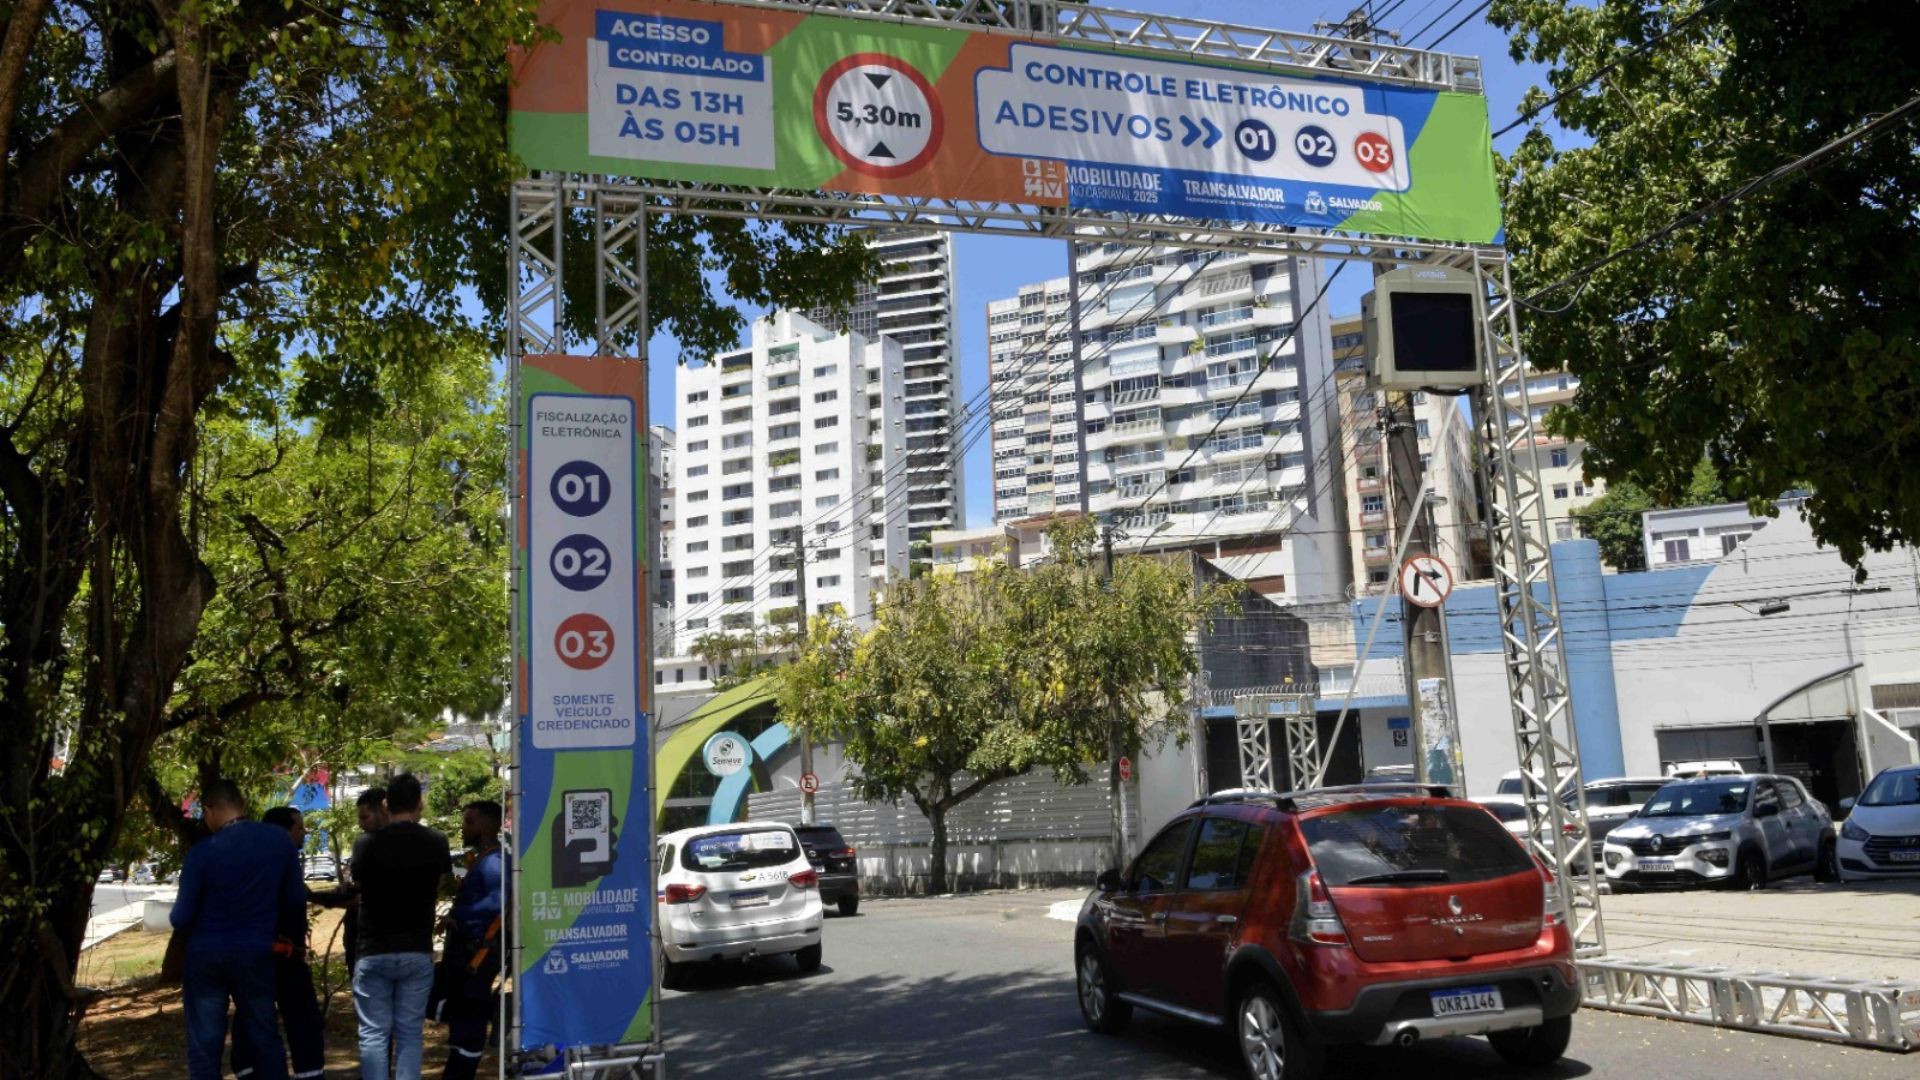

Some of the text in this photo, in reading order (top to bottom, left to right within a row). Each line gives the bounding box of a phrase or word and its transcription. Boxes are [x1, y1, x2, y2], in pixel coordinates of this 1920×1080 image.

[611, 19, 710, 44] ACESSO
[616, 47, 754, 74] CONTROLADO
[616, 83, 744, 116] DAS 13H
[1025, 61, 1350, 117] CONTROLE ELETRÔNICO
[836, 102, 921, 128] 5,30m
[995, 101, 1173, 142] ADESIVOS
[618, 111, 740, 147] ÀS 05H
[1239, 127, 1270, 151] 01
[1297, 134, 1334, 158] 02
[1356, 140, 1391, 164] 03
[1065, 165, 1162, 191] MOBILIDADE
[1085, 186, 1133, 201] CARNAVAL
[1133, 190, 1159, 203] 2025
[1183, 180, 1285, 203] TRANSALVADOR
[1329, 197, 1383, 212] SALVADOR
[536, 411, 628, 425] FISCALIZAÇÃO
[542, 426, 621, 438] ELETRÔNICA
[557, 474, 600, 503] 01
[554, 548, 606, 577] 02
[559, 630, 608, 658] 03
[553, 694, 615, 705] SOMENTE
[556, 705, 611, 717] VEÍCULO
[537, 719, 630, 731] CREDENCIADO
[563, 888, 639, 906] MOBILIDADE
[616, 903, 635, 913] 2025
[544, 924, 628, 941] TRANSALVADOR
[571, 949, 629, 964] SALVADOR
[1438, 993, 1496, 1013] OKR1146
